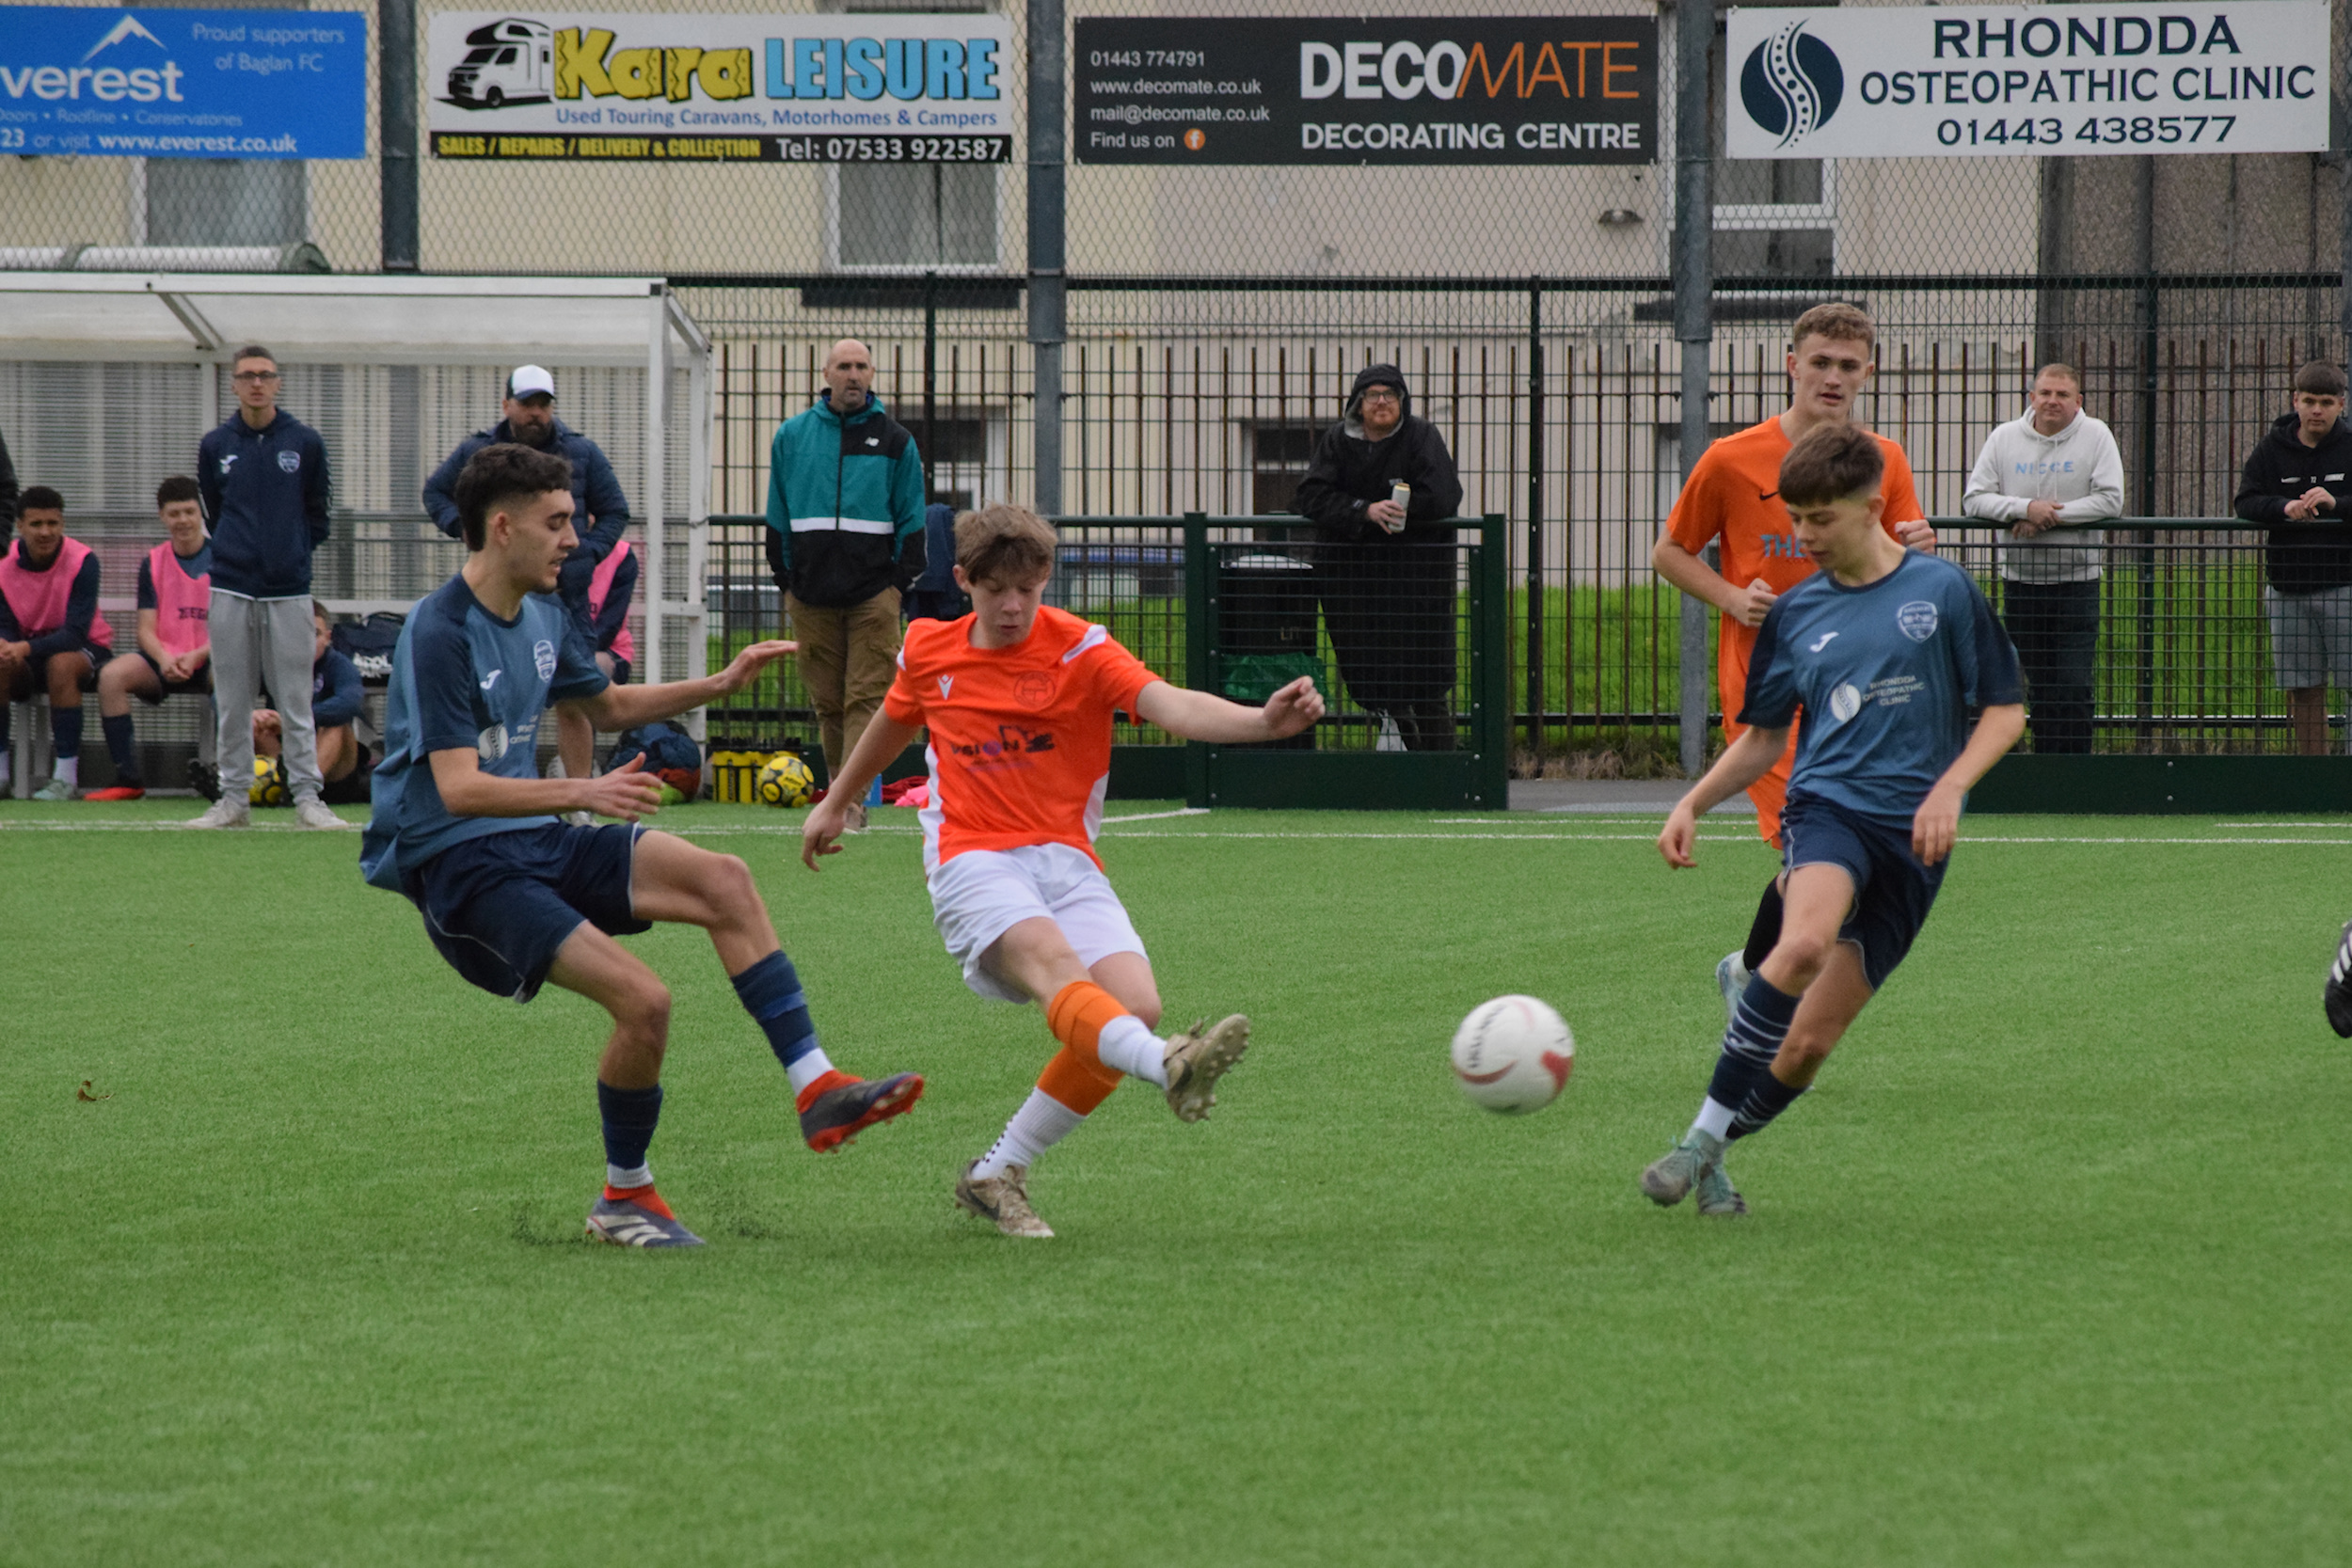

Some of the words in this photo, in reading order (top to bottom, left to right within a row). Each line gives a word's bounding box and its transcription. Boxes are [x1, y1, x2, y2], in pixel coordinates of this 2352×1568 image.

[1933, 15, 2242, 58] RHONDDA
[299, 53, 325, 72] FC
[553, 26, 753, 102] Kara
[765, 38, 1000, 100] LEISURE
[1090, 51, 1142, 67] 01443
[1145, 51, 1205, 67] 774791
[1090, 78, 1263, 94] www.decomate.co.uk
[1860, 67, 2159, 105] OSTEOPATHIC
[2172, 65, 2316, 101] CLINIC
[556, 108, 601, 123] Used
[607, 107, 675, 127] Touring
[680, 108, 767, 127] Caravans,
[772, 109, 891, 125] Motorhomes
[897, 110, 911, 125] &
[917, 110, 997, 130] Campers
[1090, 104, 1270, 125] mail@decomate.co.uk
[97, 132, 298, 152] www.everest.co.uk
[1090, 132, 1126, 148] Find
[1130, 135, 1151, 148] us
[1154, 135, 1175, 148] on
[1302, 122, 1505, 150] DECORATING
[1516, 123, 1641, 150] CENTRE
[1937, 119, 2063, 146] 01443
[2075, 116, 2237, 144] 438577
[437, 136, 485, 155] SALES
[499, 136, 565, 156] REPAIRS
[578, 137, 652, 157] DELIVERY
[668, 138, 761, 158] COLLECTION
[776, 137, 820, 160] Tel:
[826, 138, 903, 161] 07533
[910, 138, 1004, 162] 922587
